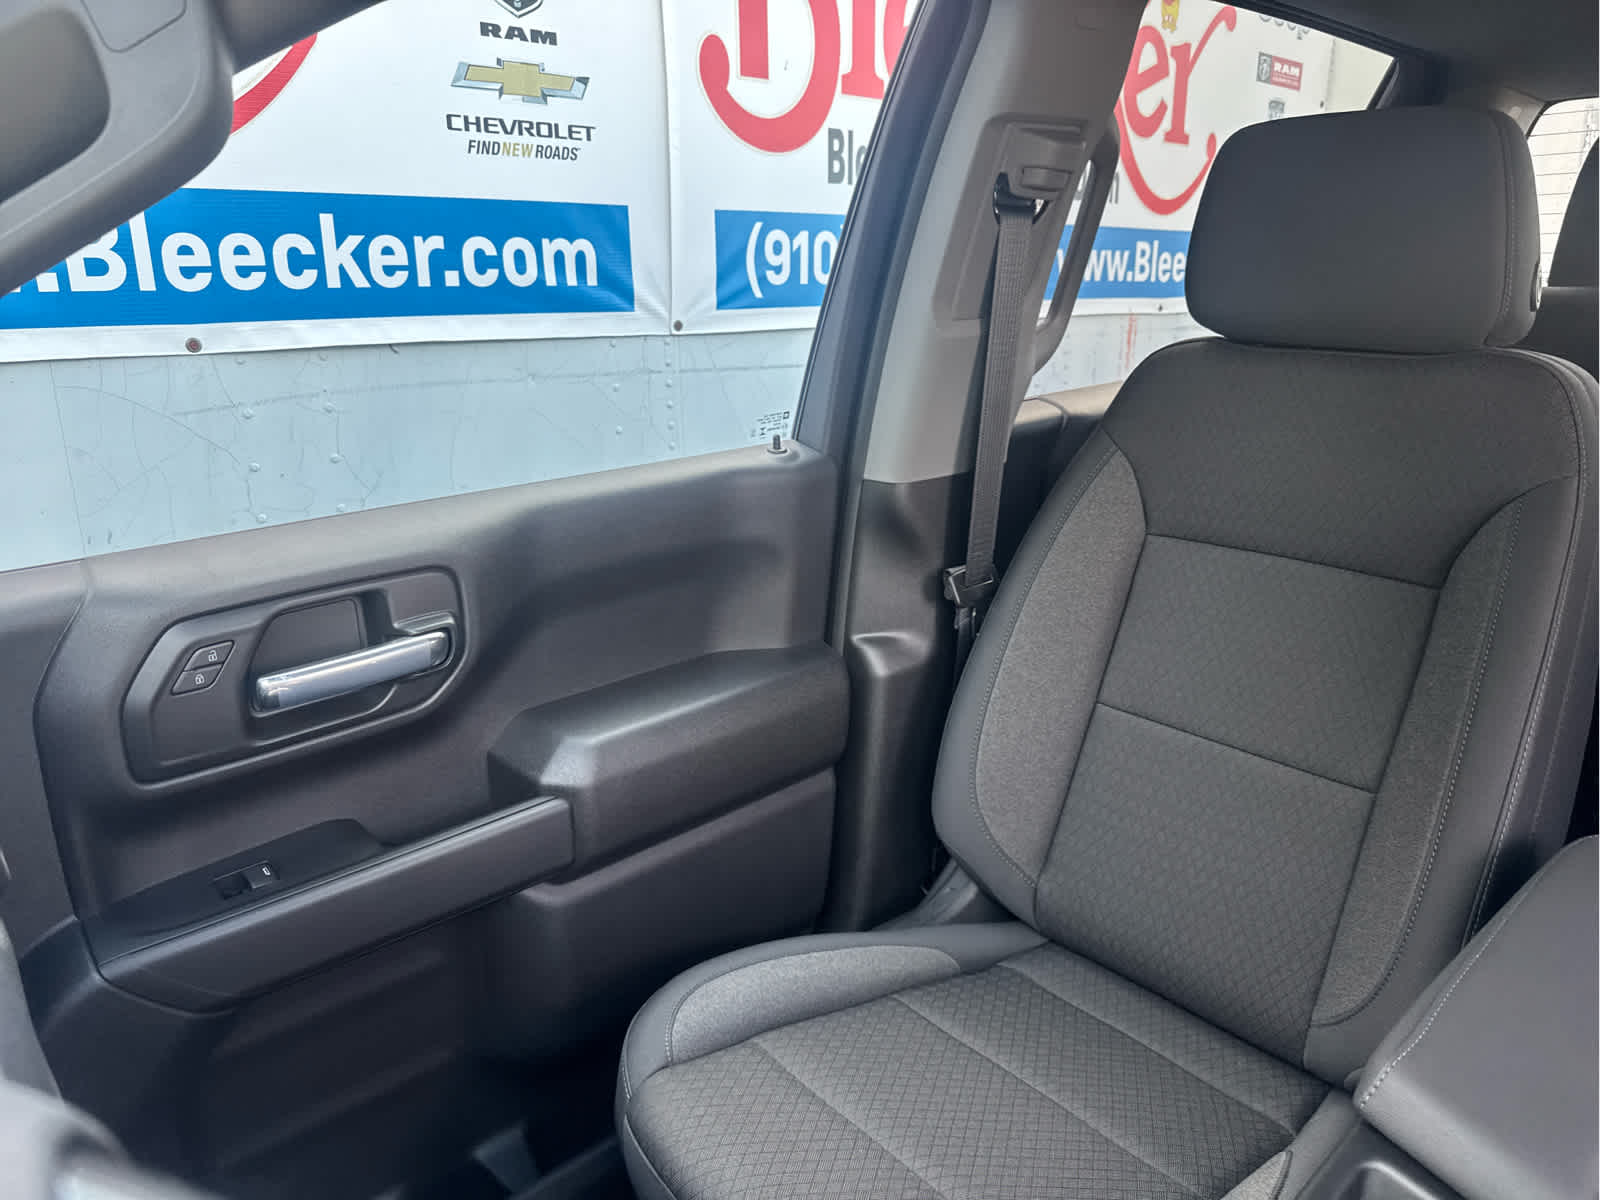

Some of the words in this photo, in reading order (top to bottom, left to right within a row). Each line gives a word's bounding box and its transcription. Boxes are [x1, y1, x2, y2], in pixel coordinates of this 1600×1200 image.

[479, 21, 558, 46] RAM
[1273, 61, 1300, 77] RAM
[446, 114, 596, 142] CHEVROLET
[10, 211, 598, 293] .Bleecker.com
[746, 221, 846, 298] (910
